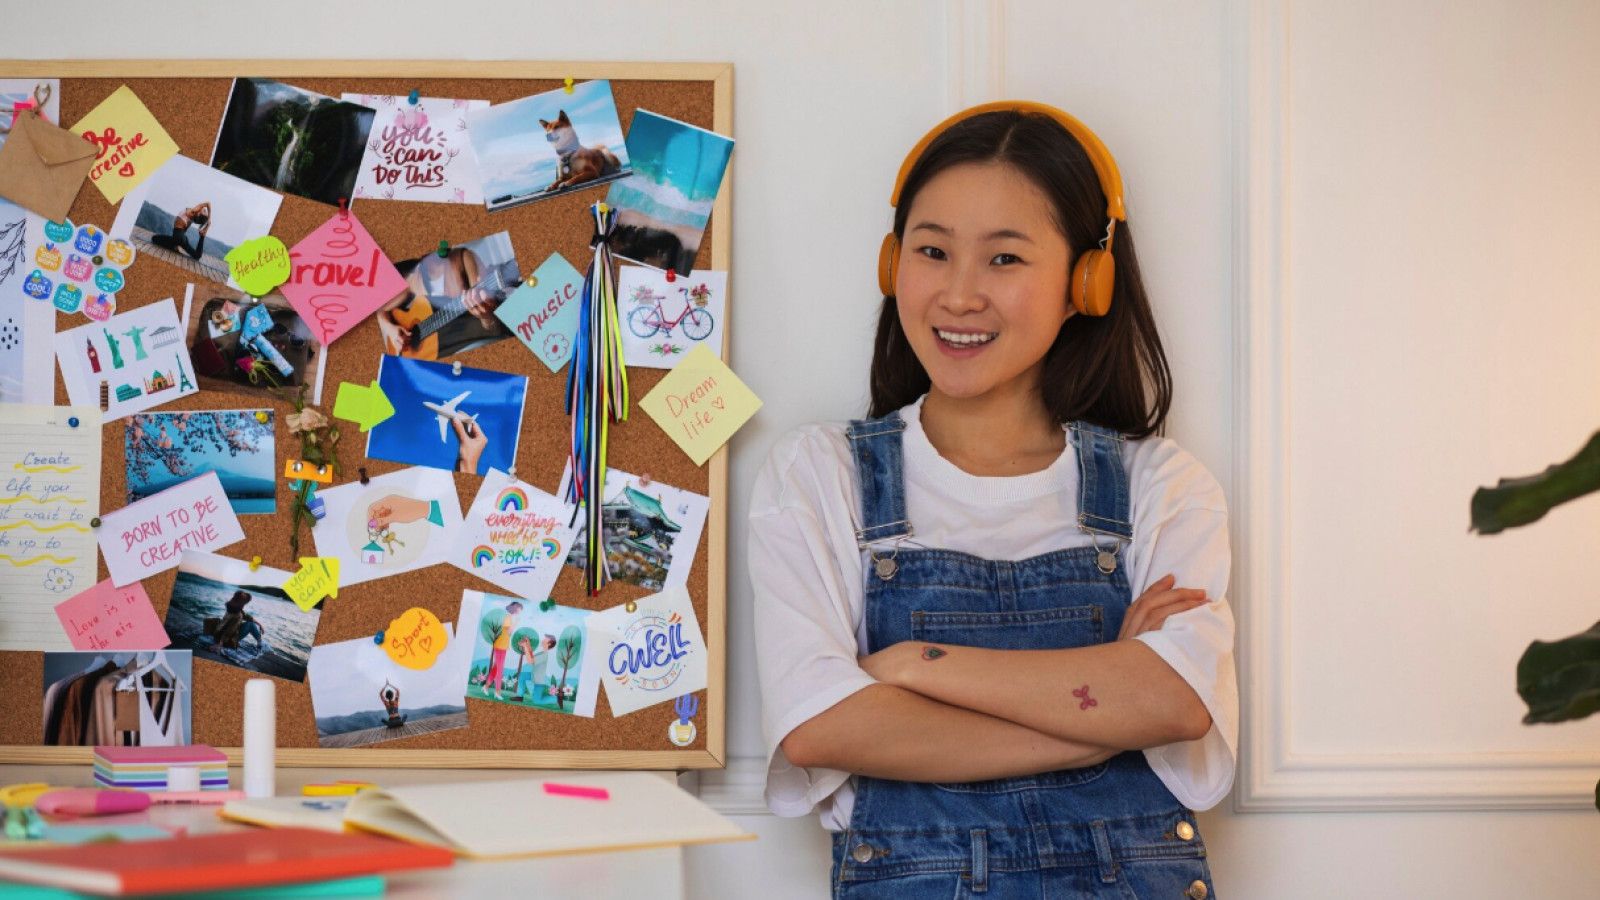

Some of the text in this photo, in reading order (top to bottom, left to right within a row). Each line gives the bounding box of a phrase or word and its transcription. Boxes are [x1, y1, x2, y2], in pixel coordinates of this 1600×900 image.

[91, 133, 149, 180] creative
[382, 125, 434, 153] you
[235, 247, 287, 282] Healthy
[289, 248, 381, 288] ravel
[517, 283, 577, 342] Music
[665, 376, 717, 418] Dream
[682, 409, 714, 440] life
[23, 451, 71, 466] Create
[6, 476, 70, 504] life you
[24, 504, 61, 520] wait
[70, 506, 84, 520] to
[121, 495, 218, 552] BORN TO BE
[485, 512, 563, 536] everything
[45, 535, 61, 549] to
[140, 523, 219, 568] CREATIVE
[69, 615, 99, 636] Love
[104, 604, 118, 616] is
[392, 611, 430, 658] Sport
[608, 622, 691, 675] WELL
